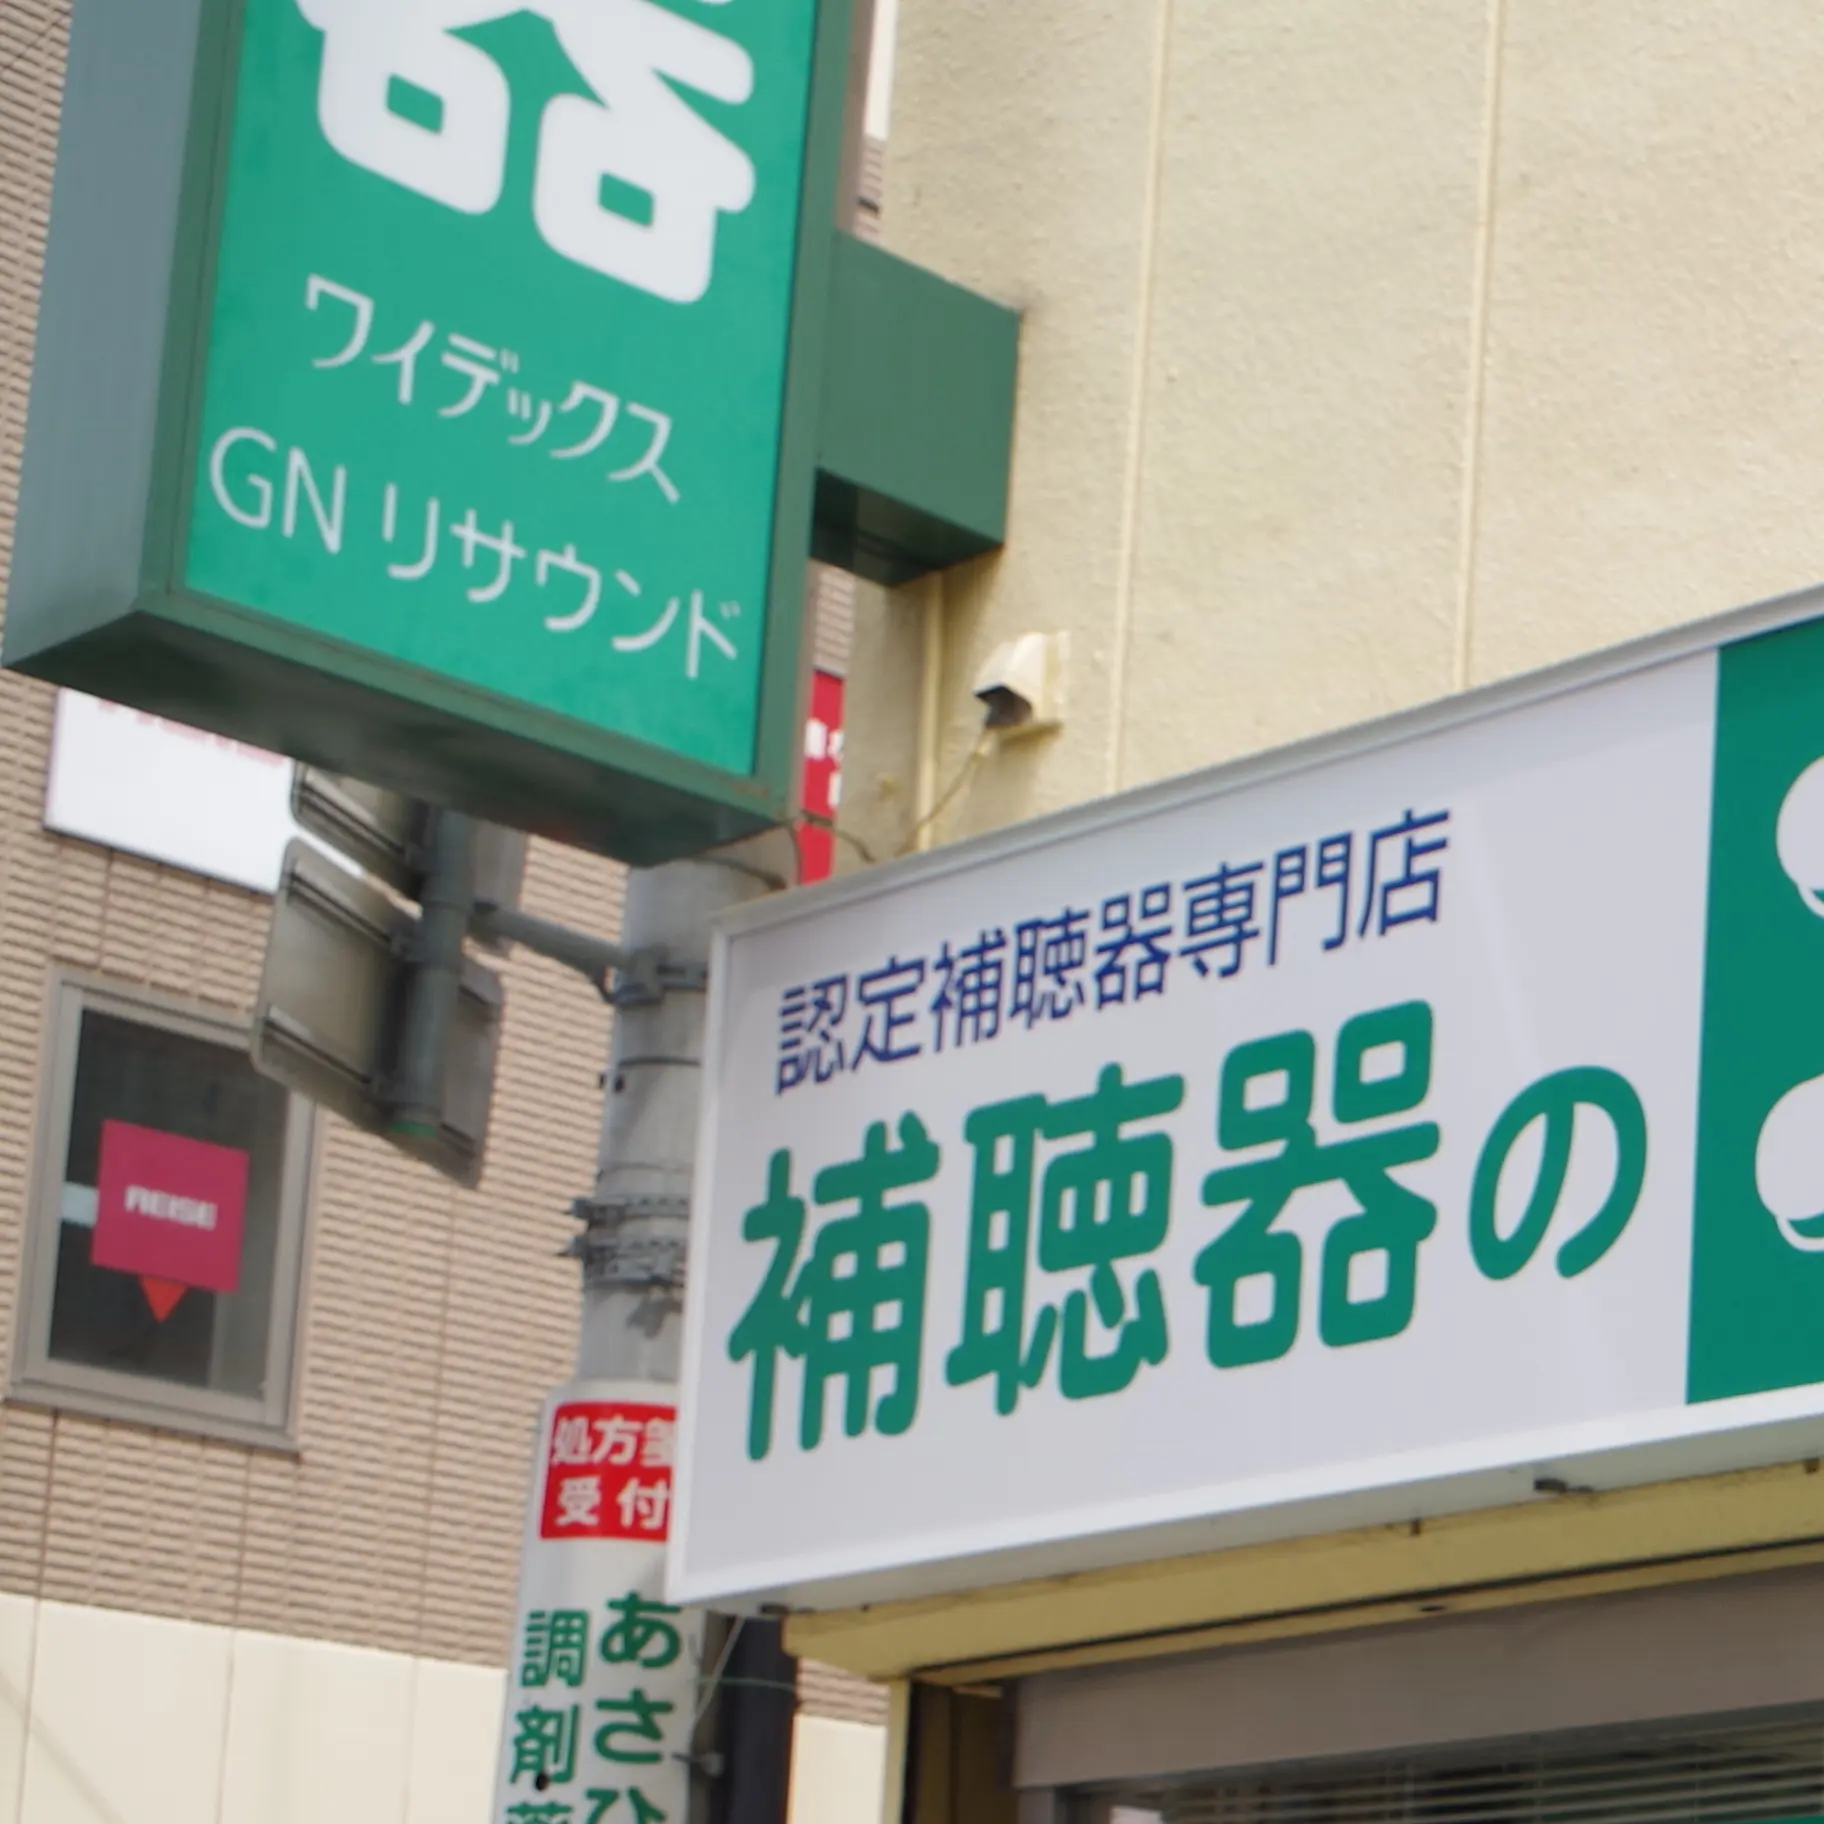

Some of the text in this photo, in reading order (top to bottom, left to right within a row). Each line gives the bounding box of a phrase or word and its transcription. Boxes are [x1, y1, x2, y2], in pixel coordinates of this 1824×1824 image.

[306, 272, 681, 505] ワイデックス
[210, 424, 742, 681] GN リサウンド
[775, 808, 1451, 1097] 認定補聴器専門店
[727, 997, 1649, 1464] 補聴器の
[554, 1475, 669, 1530] 受付
